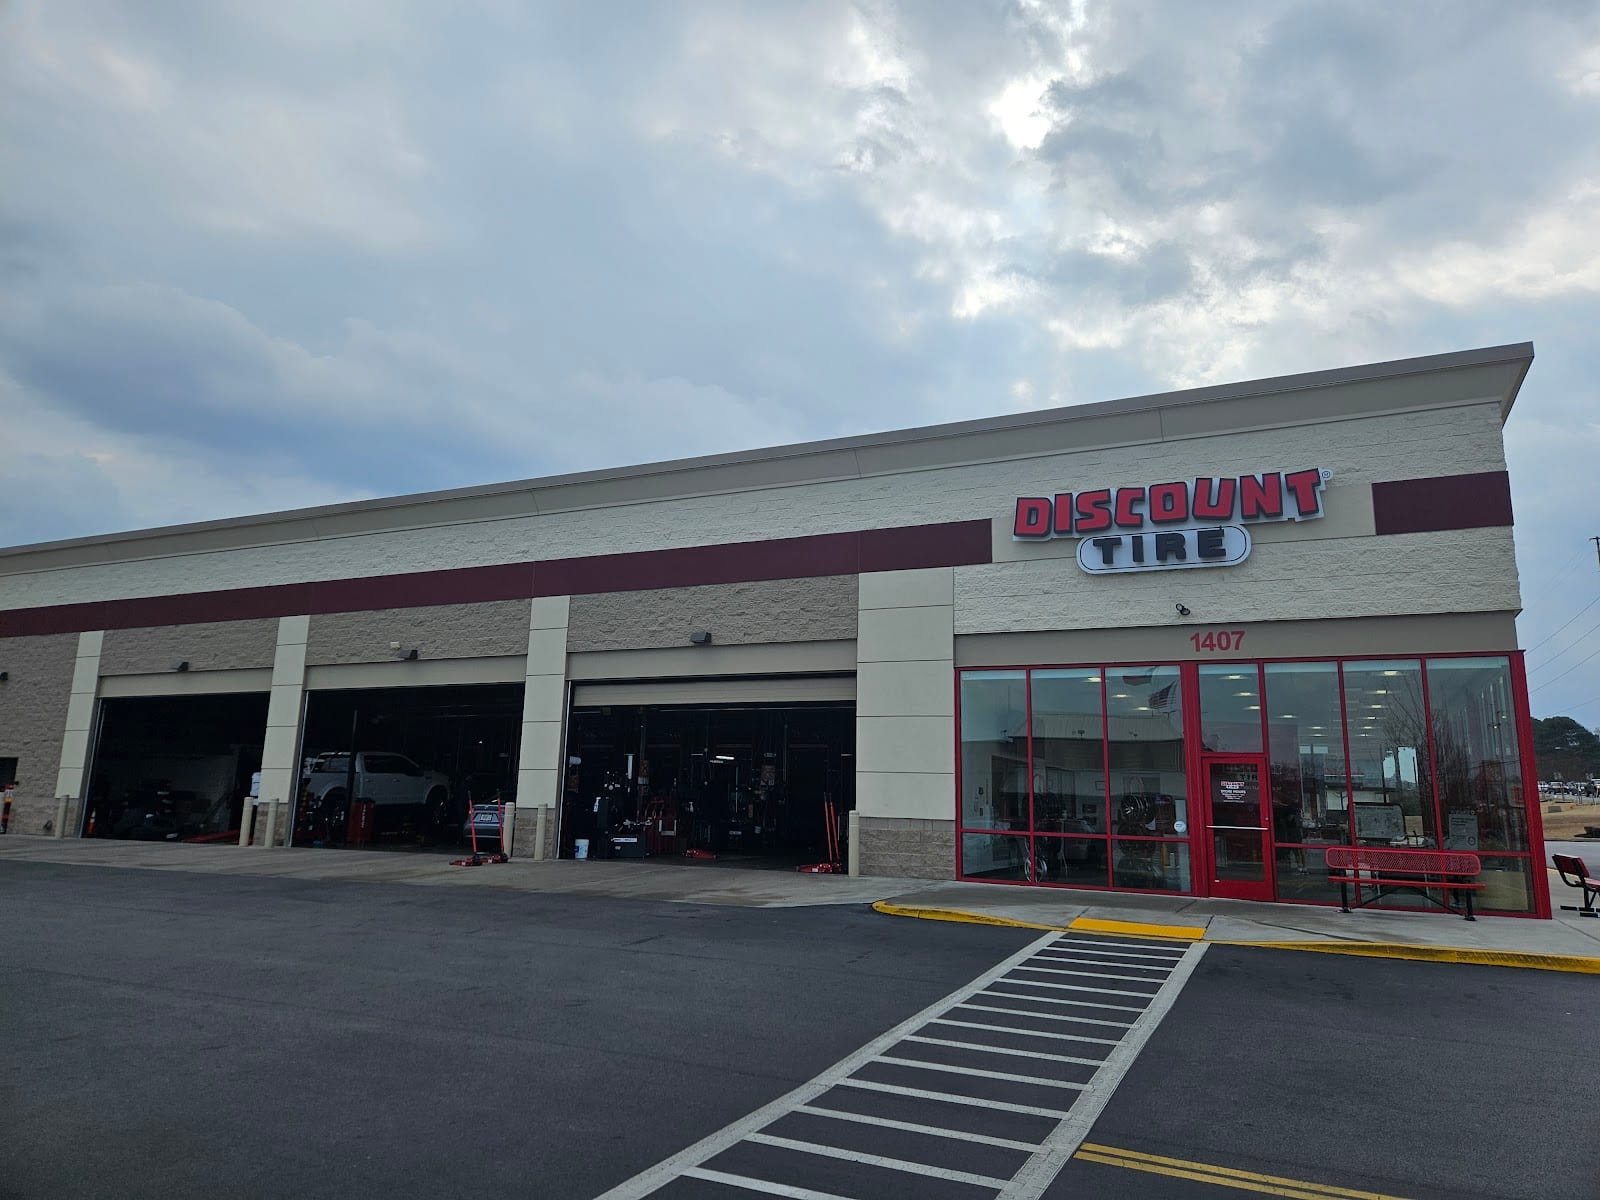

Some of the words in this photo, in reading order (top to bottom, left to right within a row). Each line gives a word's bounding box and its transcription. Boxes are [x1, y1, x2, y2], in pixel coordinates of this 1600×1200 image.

[1014, 469, 1321, 537] DISCOUNT
[1093, 528, 1227, 564] TIRE
[1190, 631, 1246, 652] 1407
